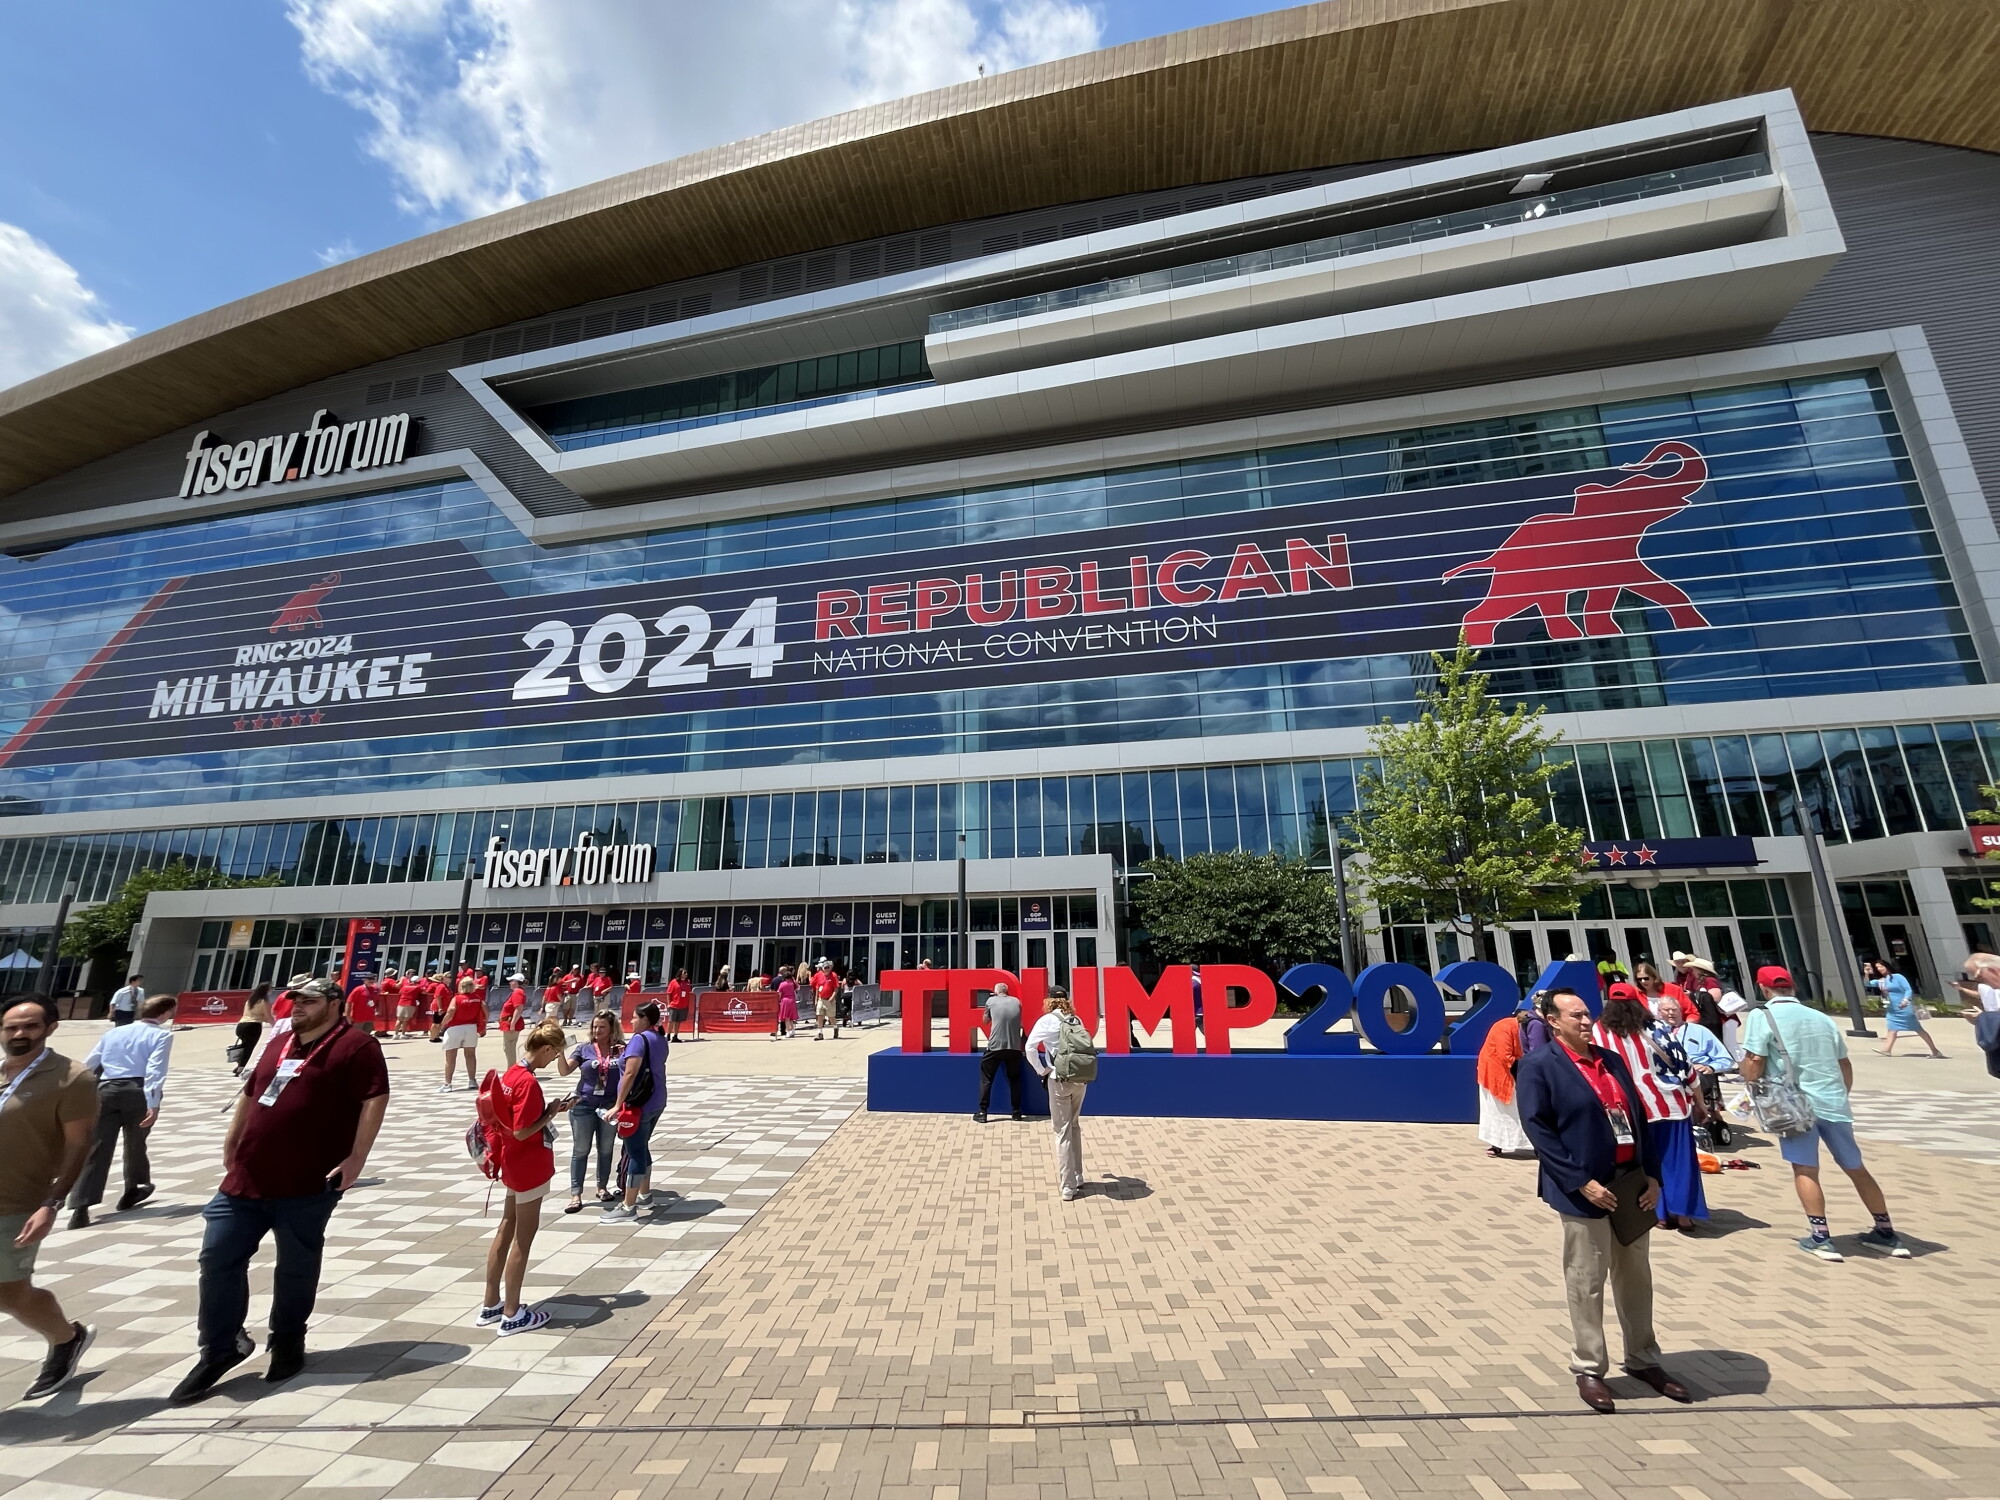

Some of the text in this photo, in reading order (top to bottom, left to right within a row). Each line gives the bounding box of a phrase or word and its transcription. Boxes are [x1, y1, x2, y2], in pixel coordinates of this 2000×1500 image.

[814, 533, 1354, 645] REPUBLICAN
[235, 634, 353, 667] RNC 2024
[511, 596, 785, 701] 2024
[813, 613, 1218, 676] NATIONAL CONVENTION
[148, 652, 432, 719] MILWAUKEE
[880, 963, 1278, 1056] TRUMP
